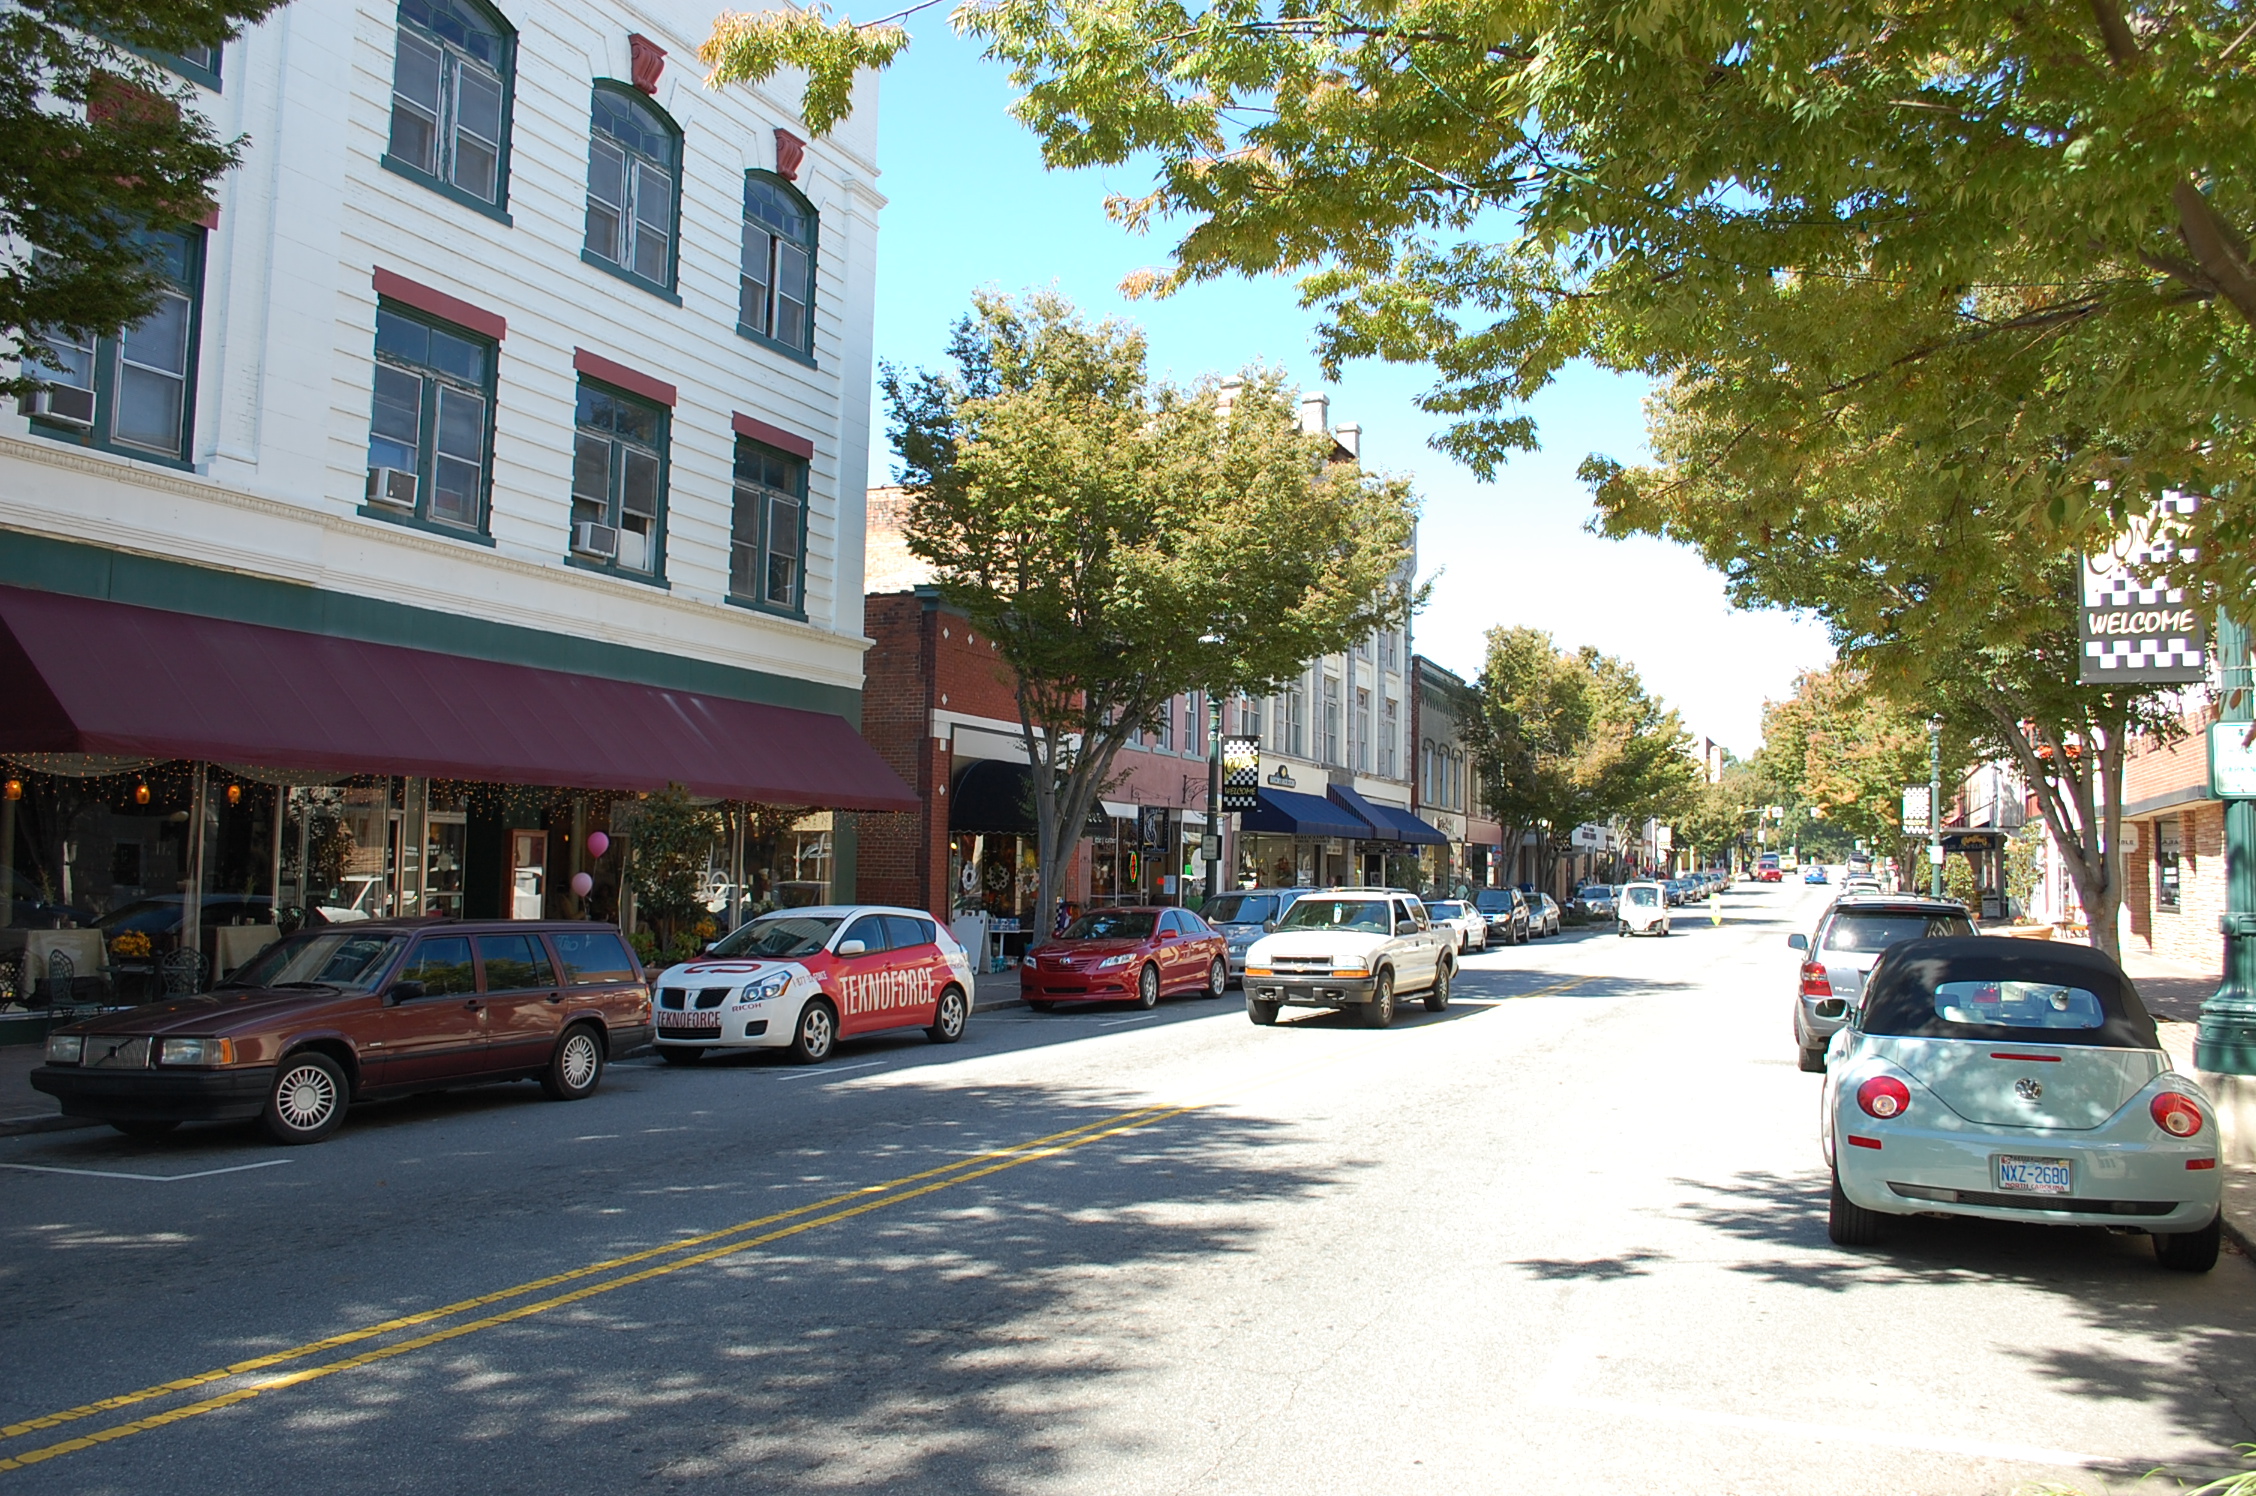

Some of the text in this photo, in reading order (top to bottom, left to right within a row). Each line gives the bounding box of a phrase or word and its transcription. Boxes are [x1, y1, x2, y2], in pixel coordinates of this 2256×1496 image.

[2088, 608, 2195, 635] WELCOME
[1224, 787, 1256, 796] WELCOME
[839, 967, 935, 1016] TEKNOFORCE
[731, 1002, 762, 1012] RICOH
[657, 1011, 721, 1028] TEKNOFORCE
[2001, 1164, 2069, 1185] NXZ-2680
[2005, 1182, 2065, 1192] NORTH CAROLINA
